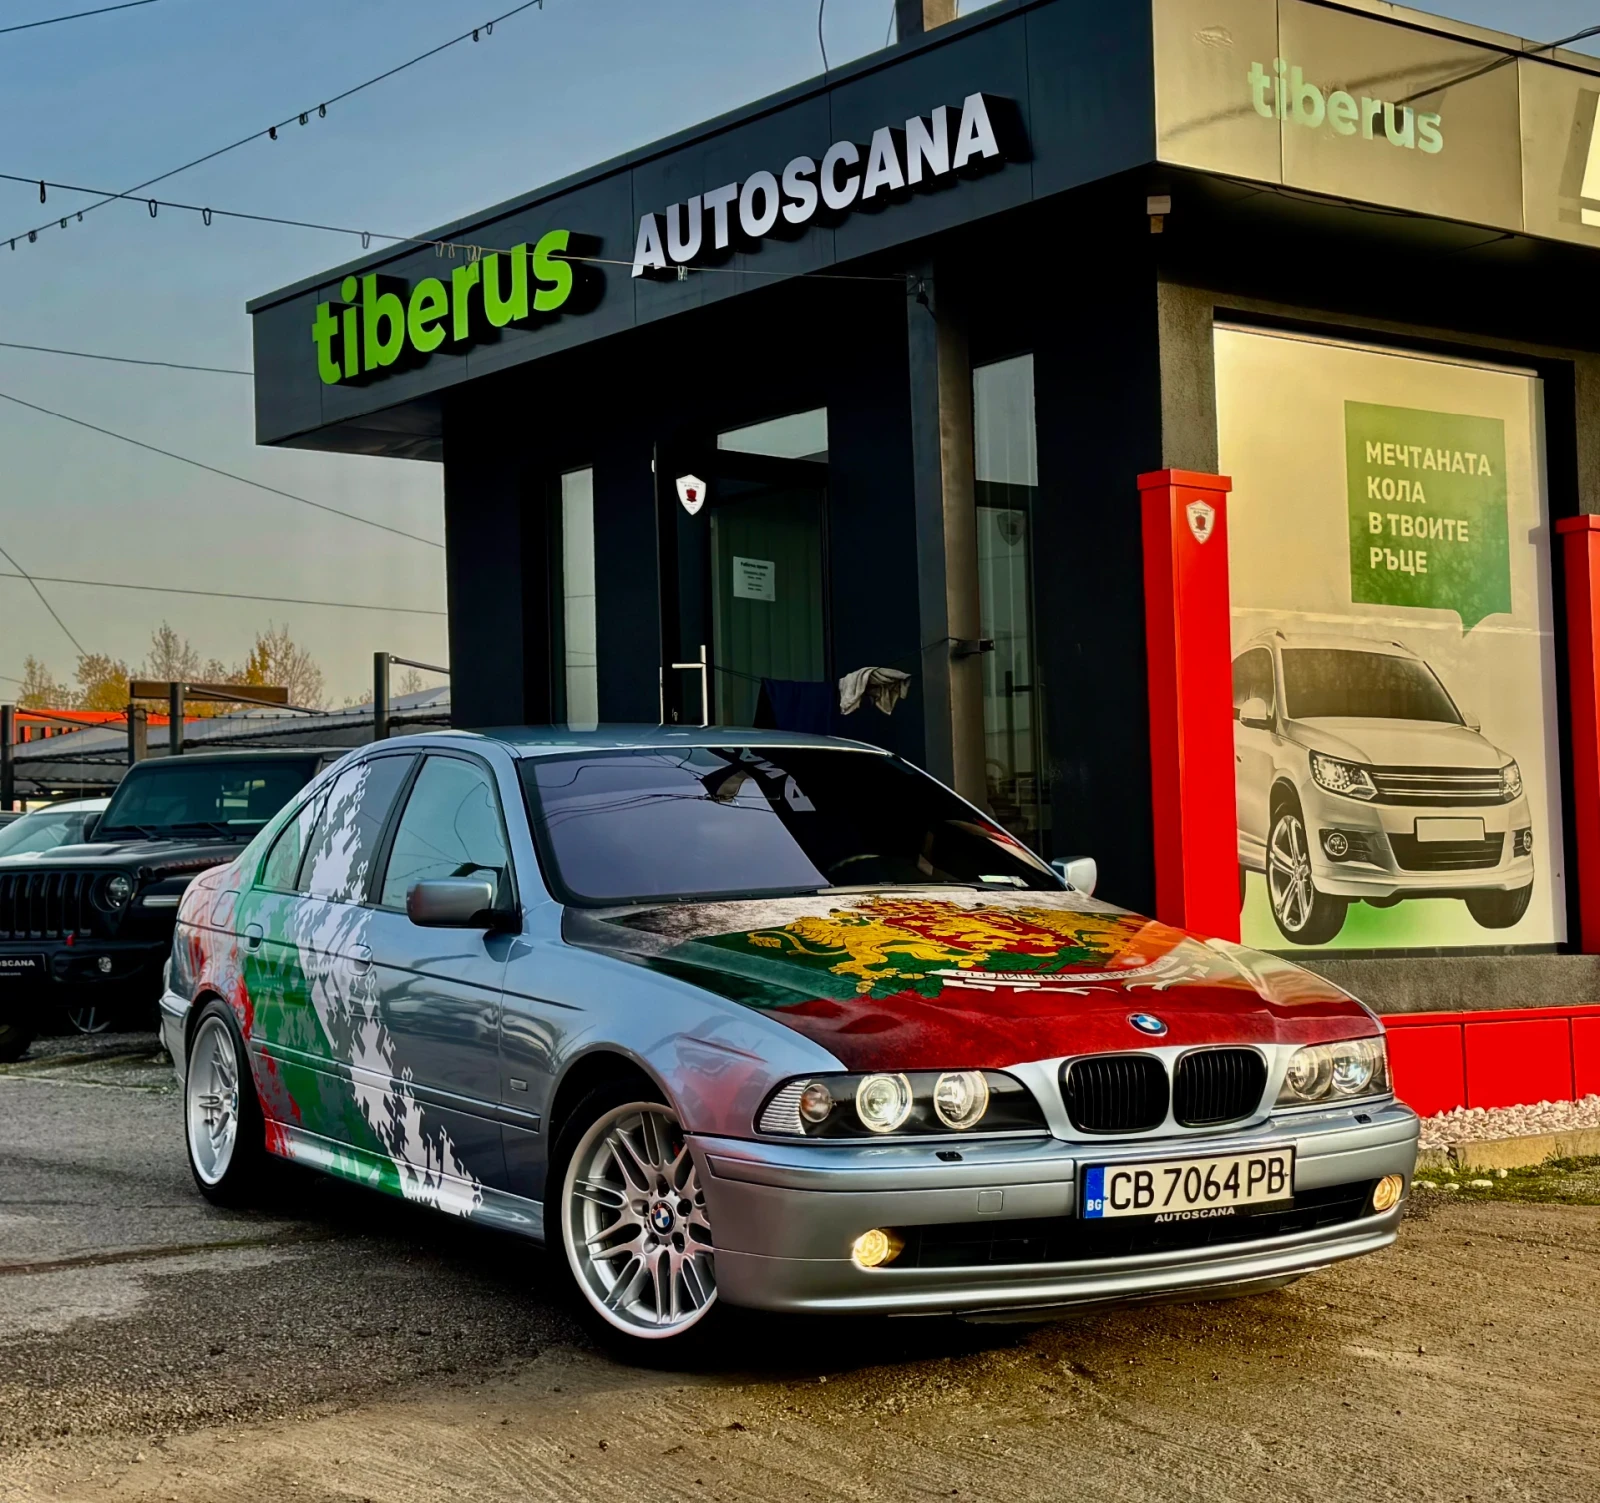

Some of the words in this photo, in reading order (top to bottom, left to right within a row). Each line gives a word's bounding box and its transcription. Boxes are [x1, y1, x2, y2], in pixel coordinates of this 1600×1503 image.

[1247, 57, 1444, 154] tiberus
[630, 91, 1000, 278] AUTOSCANA
[312, 228, 573, 385] tiberus
[1365, 440, 1492, 476] МЕЧТАНАТА
[1367, 475, 1426, 503] КОЛА
[1368, 511, 1383, 534] В
[1386, 513, 1469, 542] ТВОИТЕ
[1370, 546, 1428, 576] РЪЦЕ
[1162, 1162, 1240, 1206] 7064
[1087, 1198, 1102, 1211] BG
[1154, 1206, 1235, 1223] AUTOSCANA
